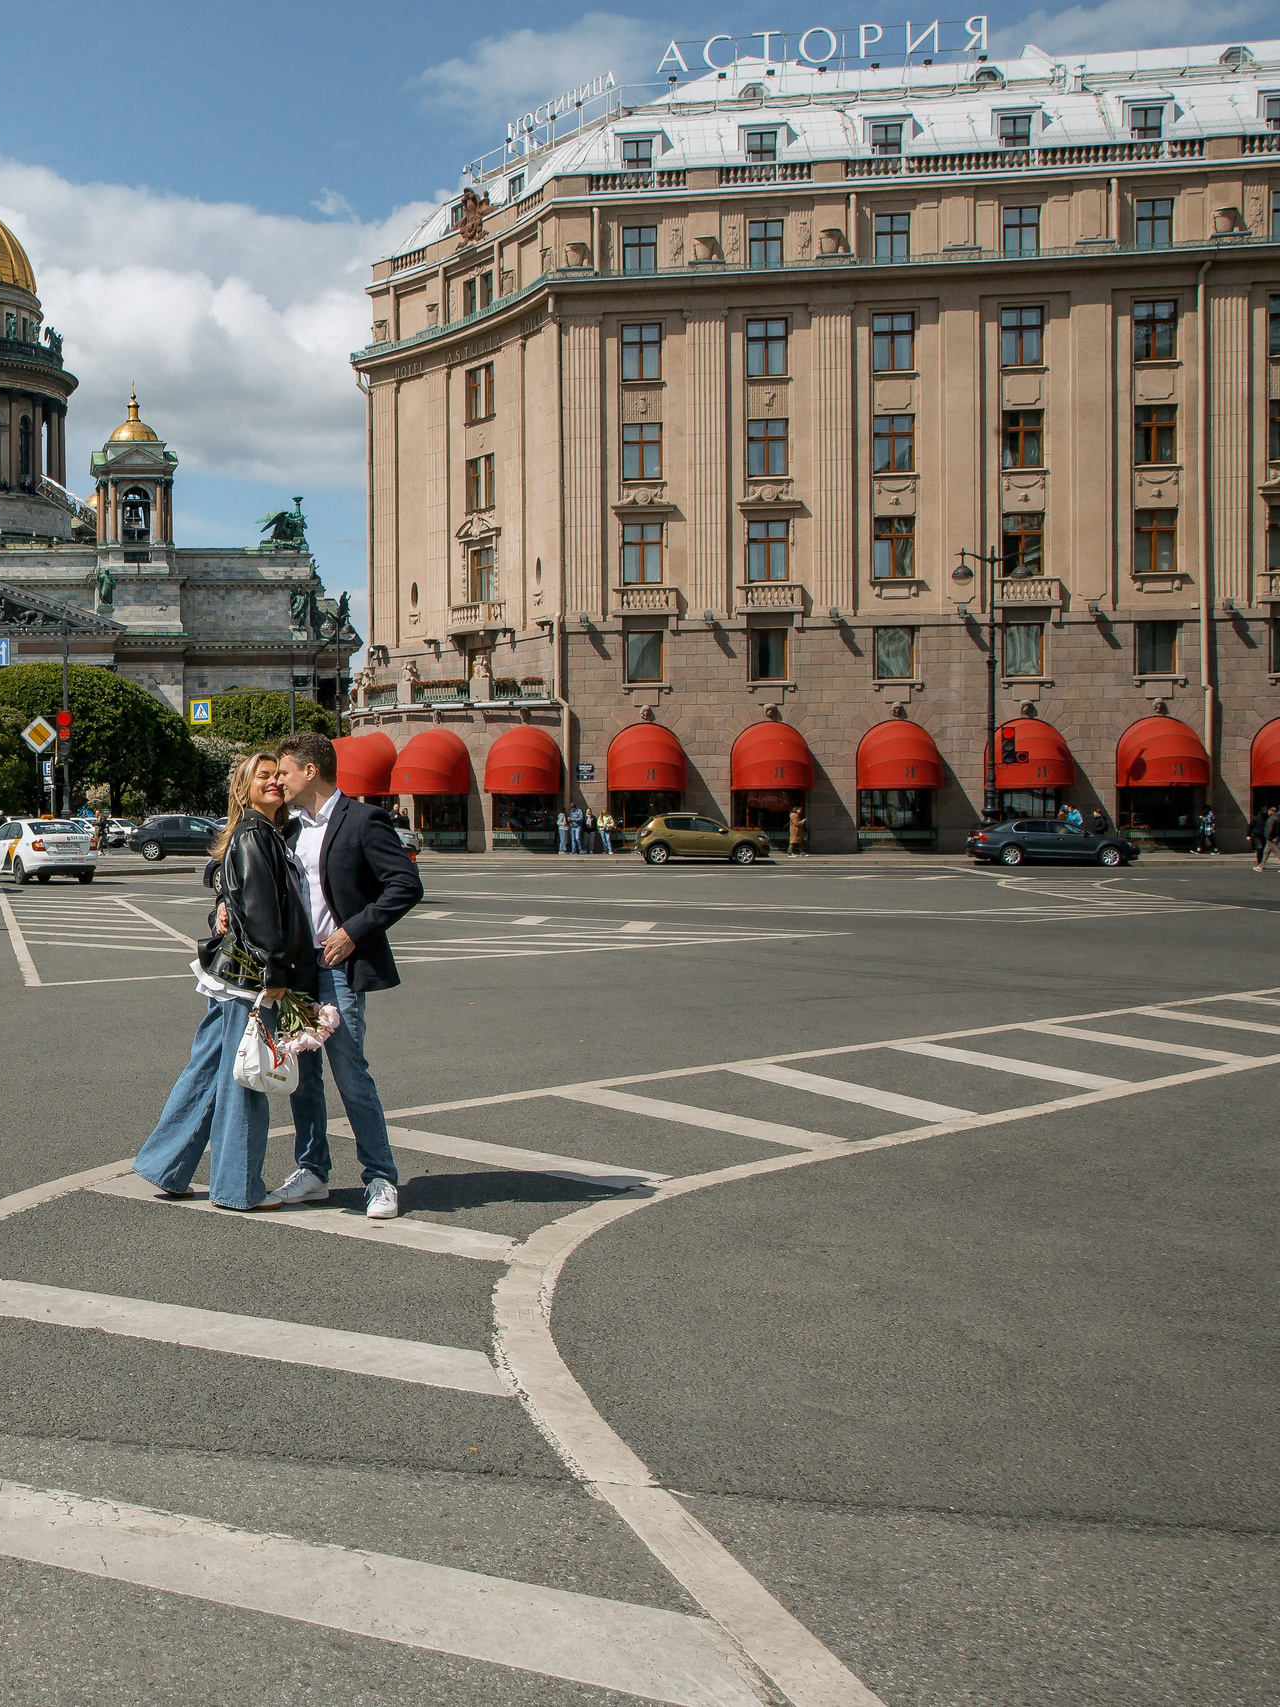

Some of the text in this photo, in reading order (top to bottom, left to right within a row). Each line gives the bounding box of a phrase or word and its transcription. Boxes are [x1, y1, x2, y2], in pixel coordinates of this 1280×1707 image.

[656, 15, 988, 74] АСТОРИЯ
[516, 70, 616, 136] ГОСТИНИЦА
[59, 728, 70, 739] 22
